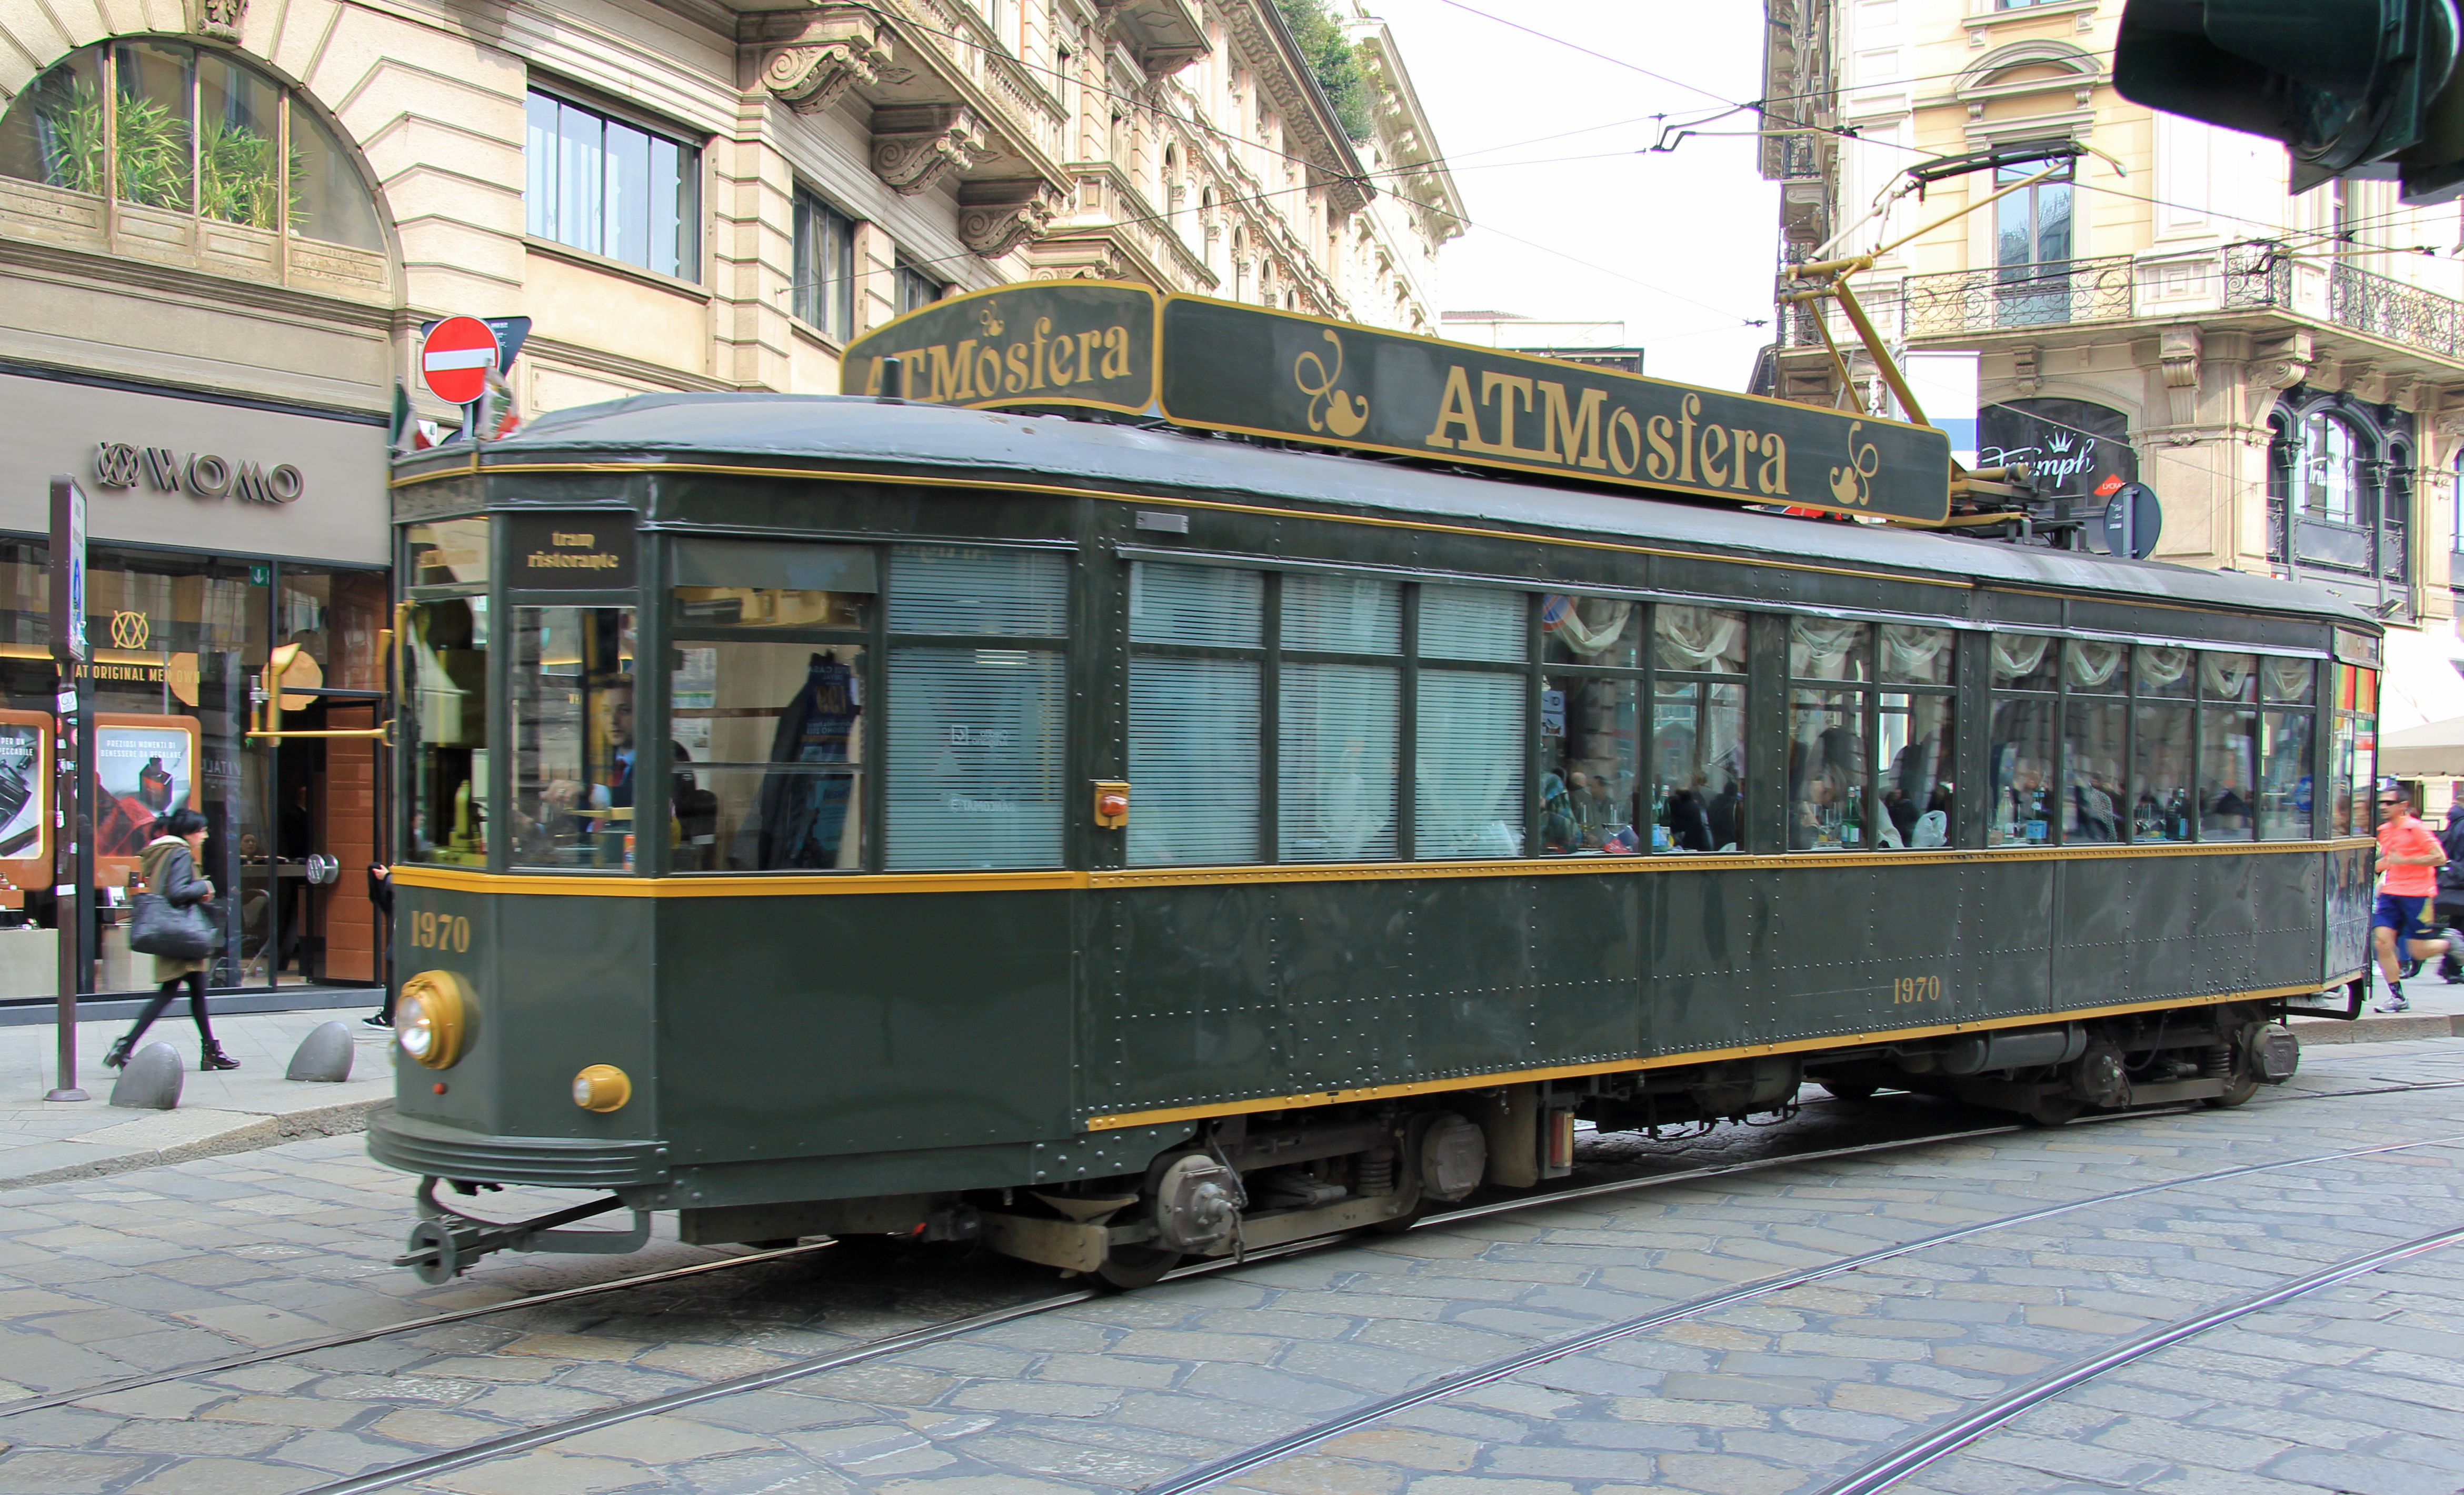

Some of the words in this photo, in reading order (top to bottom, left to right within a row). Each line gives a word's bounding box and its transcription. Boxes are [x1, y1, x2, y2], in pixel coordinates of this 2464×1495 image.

[864, 317, 1131, 403] ATMosfera
[1425, 365, 1789, 495] ATMosfera
[146, 447, 305, 503] WOMO
[552, 530, 595, 549] tram
[527, 550, 619, 571] ristorante
[56, 663, 88, 678] WAT
[92, 665, 145, 681] ORIGINAL
[148, 668, 172, 681] MEN
[177, 670, 201, 684] OWN
[100, 749, 137, 758] BENESSERE
[149, 750, 182, 759] REGALARE
[138, 740, 166, 749] MOMENTI
[411, 910, 470, 953] 1970
[1894, 975, 1940, 1004] 1970
